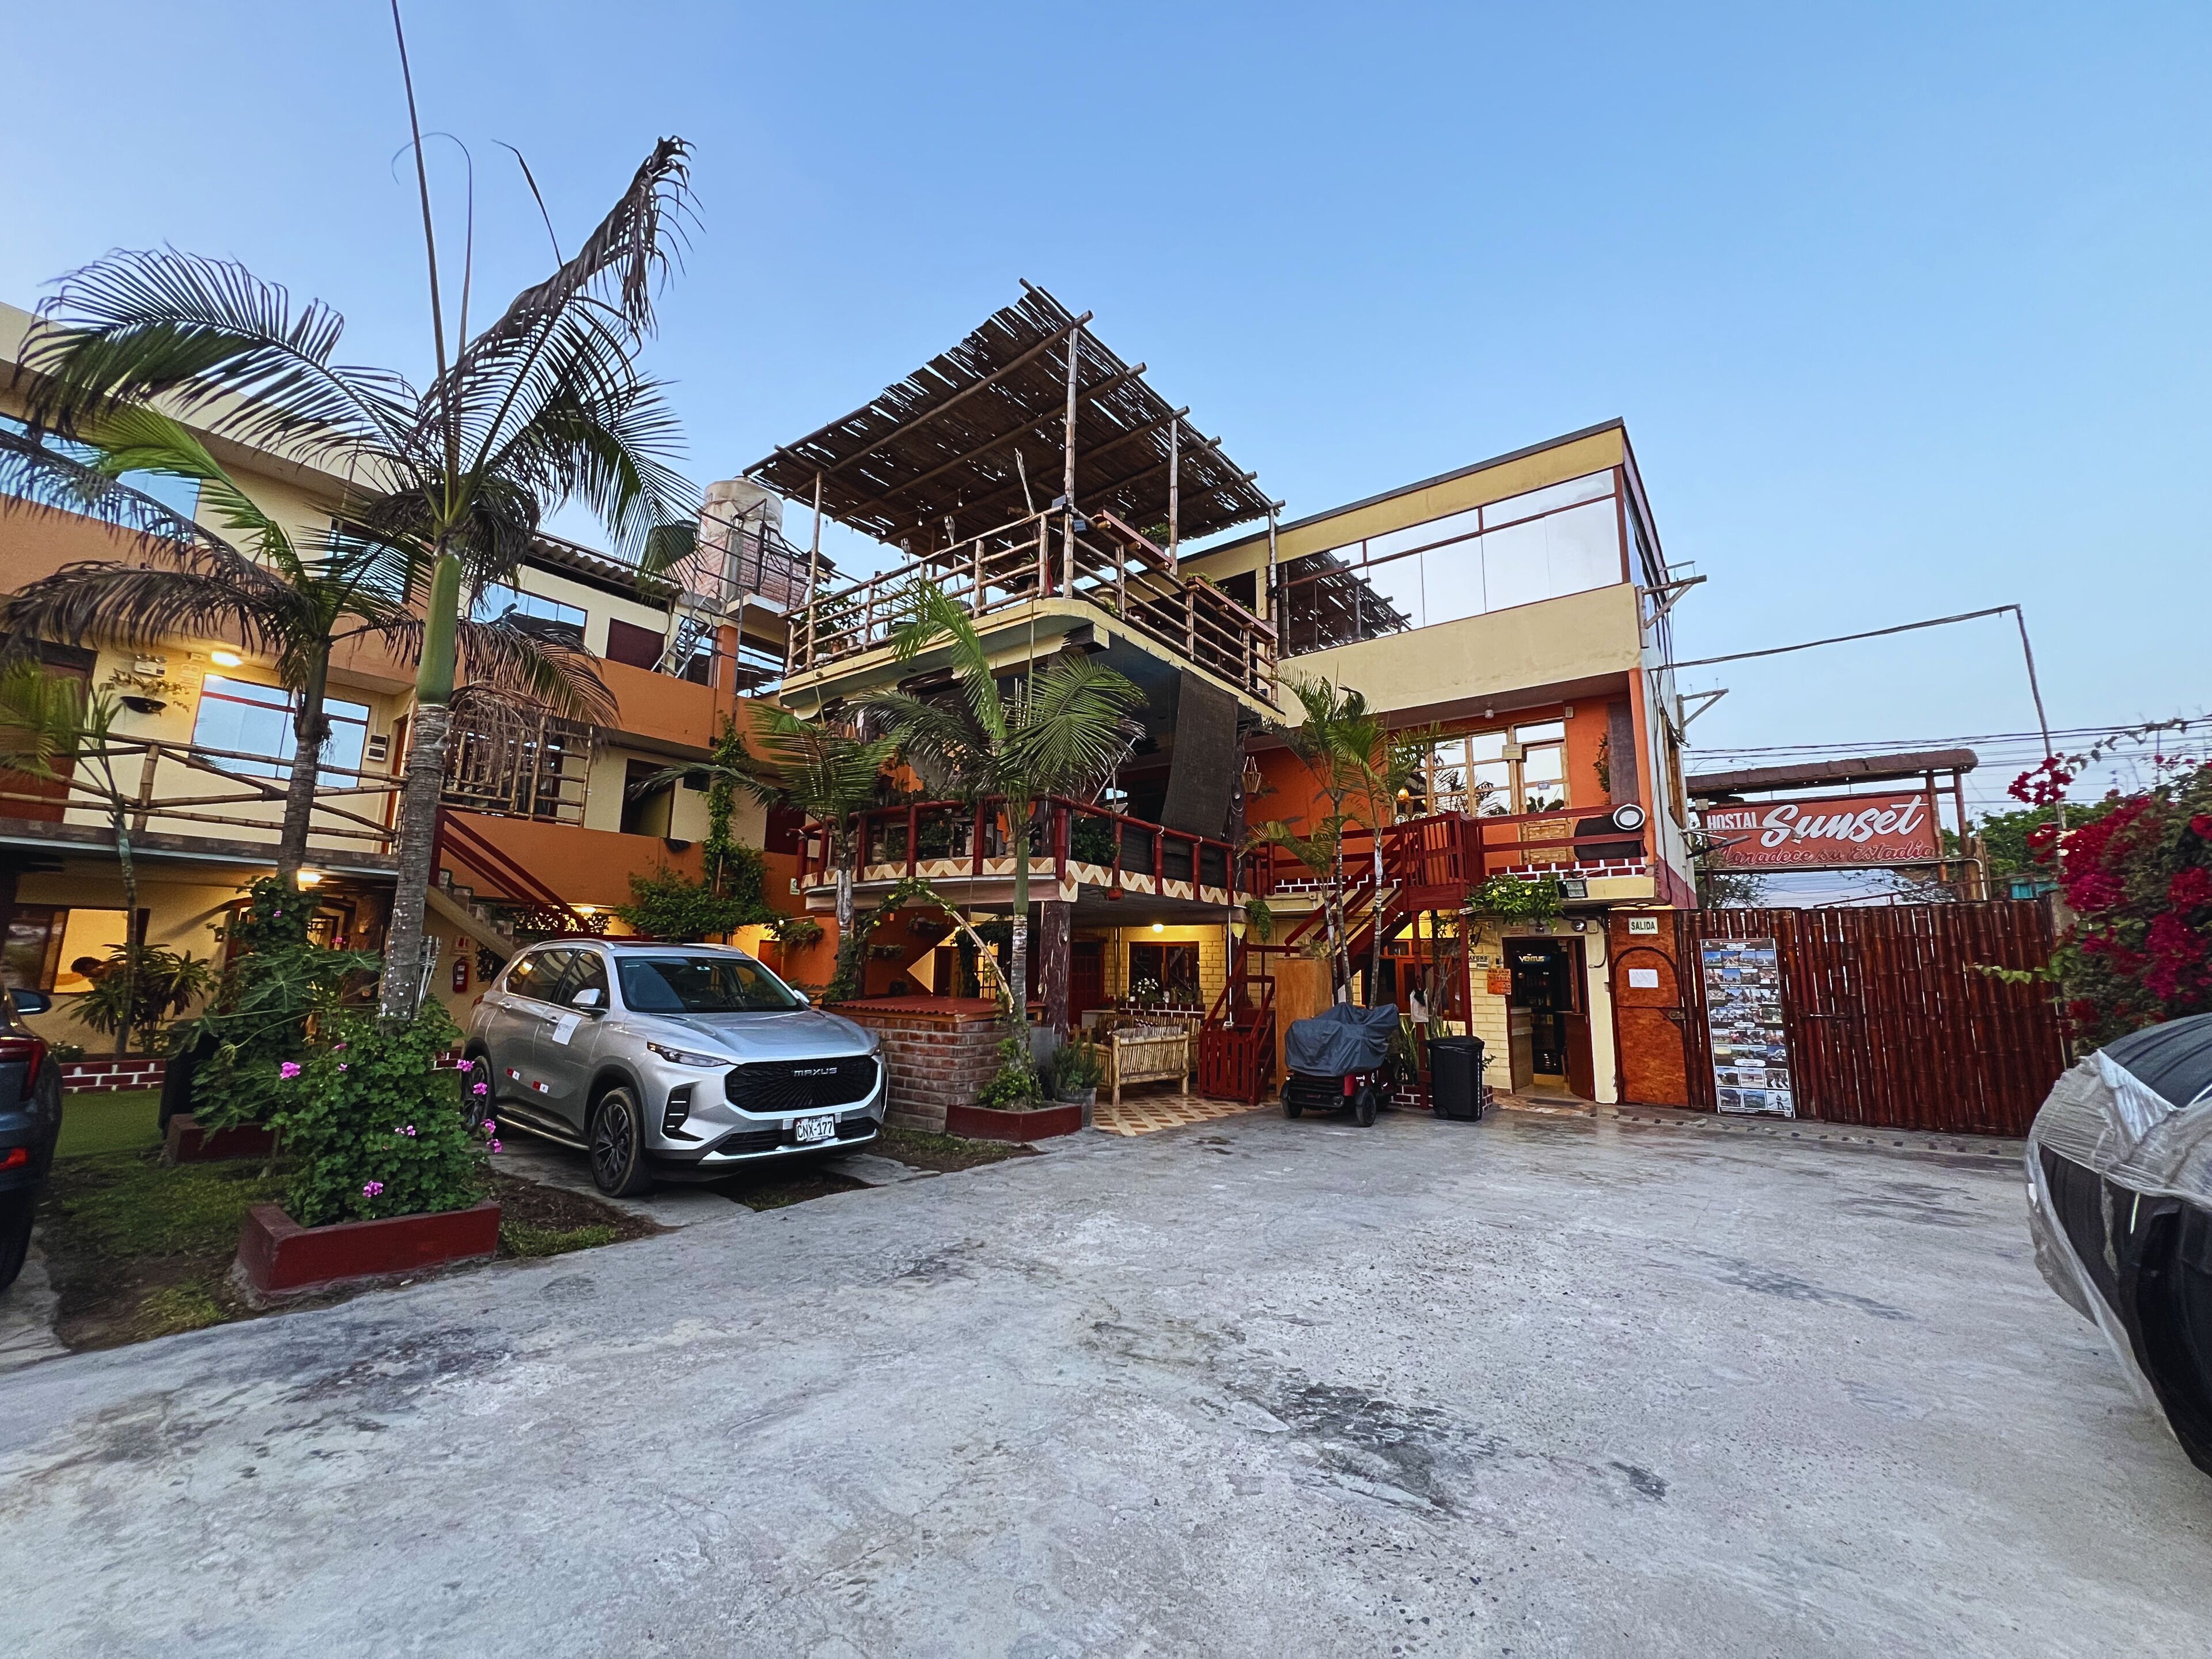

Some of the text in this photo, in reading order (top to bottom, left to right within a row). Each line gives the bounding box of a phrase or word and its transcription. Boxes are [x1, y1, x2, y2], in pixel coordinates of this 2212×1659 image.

[1761, 795, 1929, 847] Sunset
[1816, 848, 1844, 862] su
[1631, 921, 1656, 930] SALIDA
[794, 1067, 837, 1077] MAXUS
[797, 1121, 832, 1138] CNX-177
